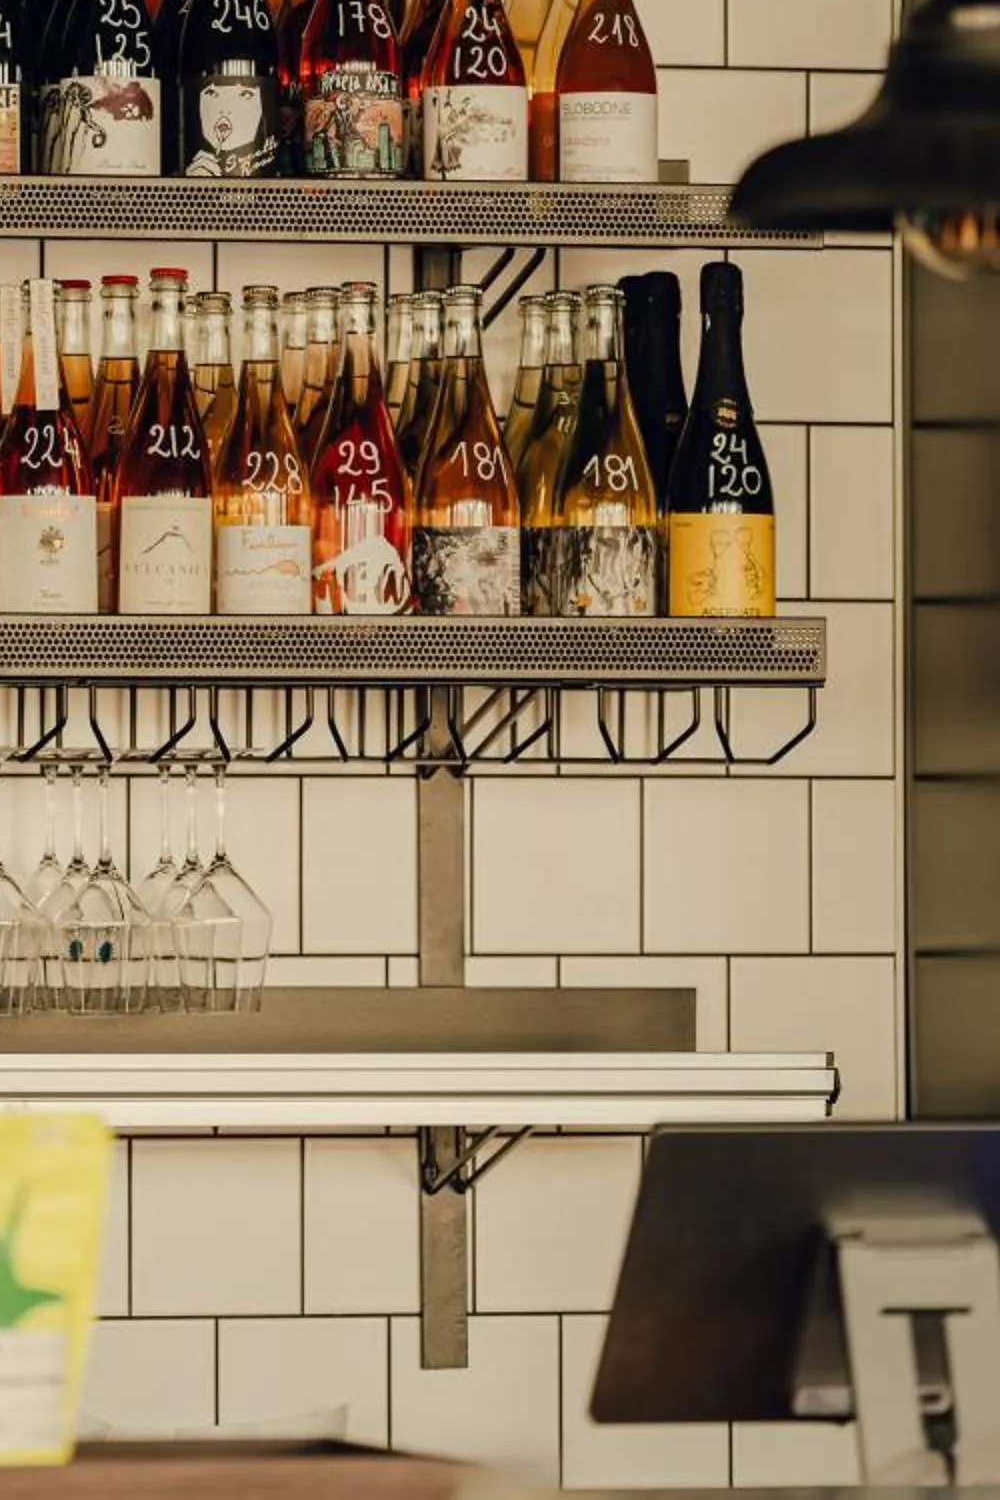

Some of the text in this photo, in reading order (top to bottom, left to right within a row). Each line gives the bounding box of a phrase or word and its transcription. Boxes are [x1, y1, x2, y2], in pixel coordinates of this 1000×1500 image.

[338, 1, 393, 40] 178
[461, 5, 502, 43] 24
[587, 13, 640, 48] 218
[95, 31, 151, 68] 125
[453, 46, 507, 79] 120
[20, 425, 81, 469] 224
[147, 424, 200, 459] 212
[338, 441, 380, 476] 29
[710, 432, 748, 465] 24
[242, 451, 302, 494] 228
[450, 441, 510, 485] 181
[583, 454, 639, 492] 181
[708, 464, 762, 498] 120
[334, 479, 393, 518] 145
